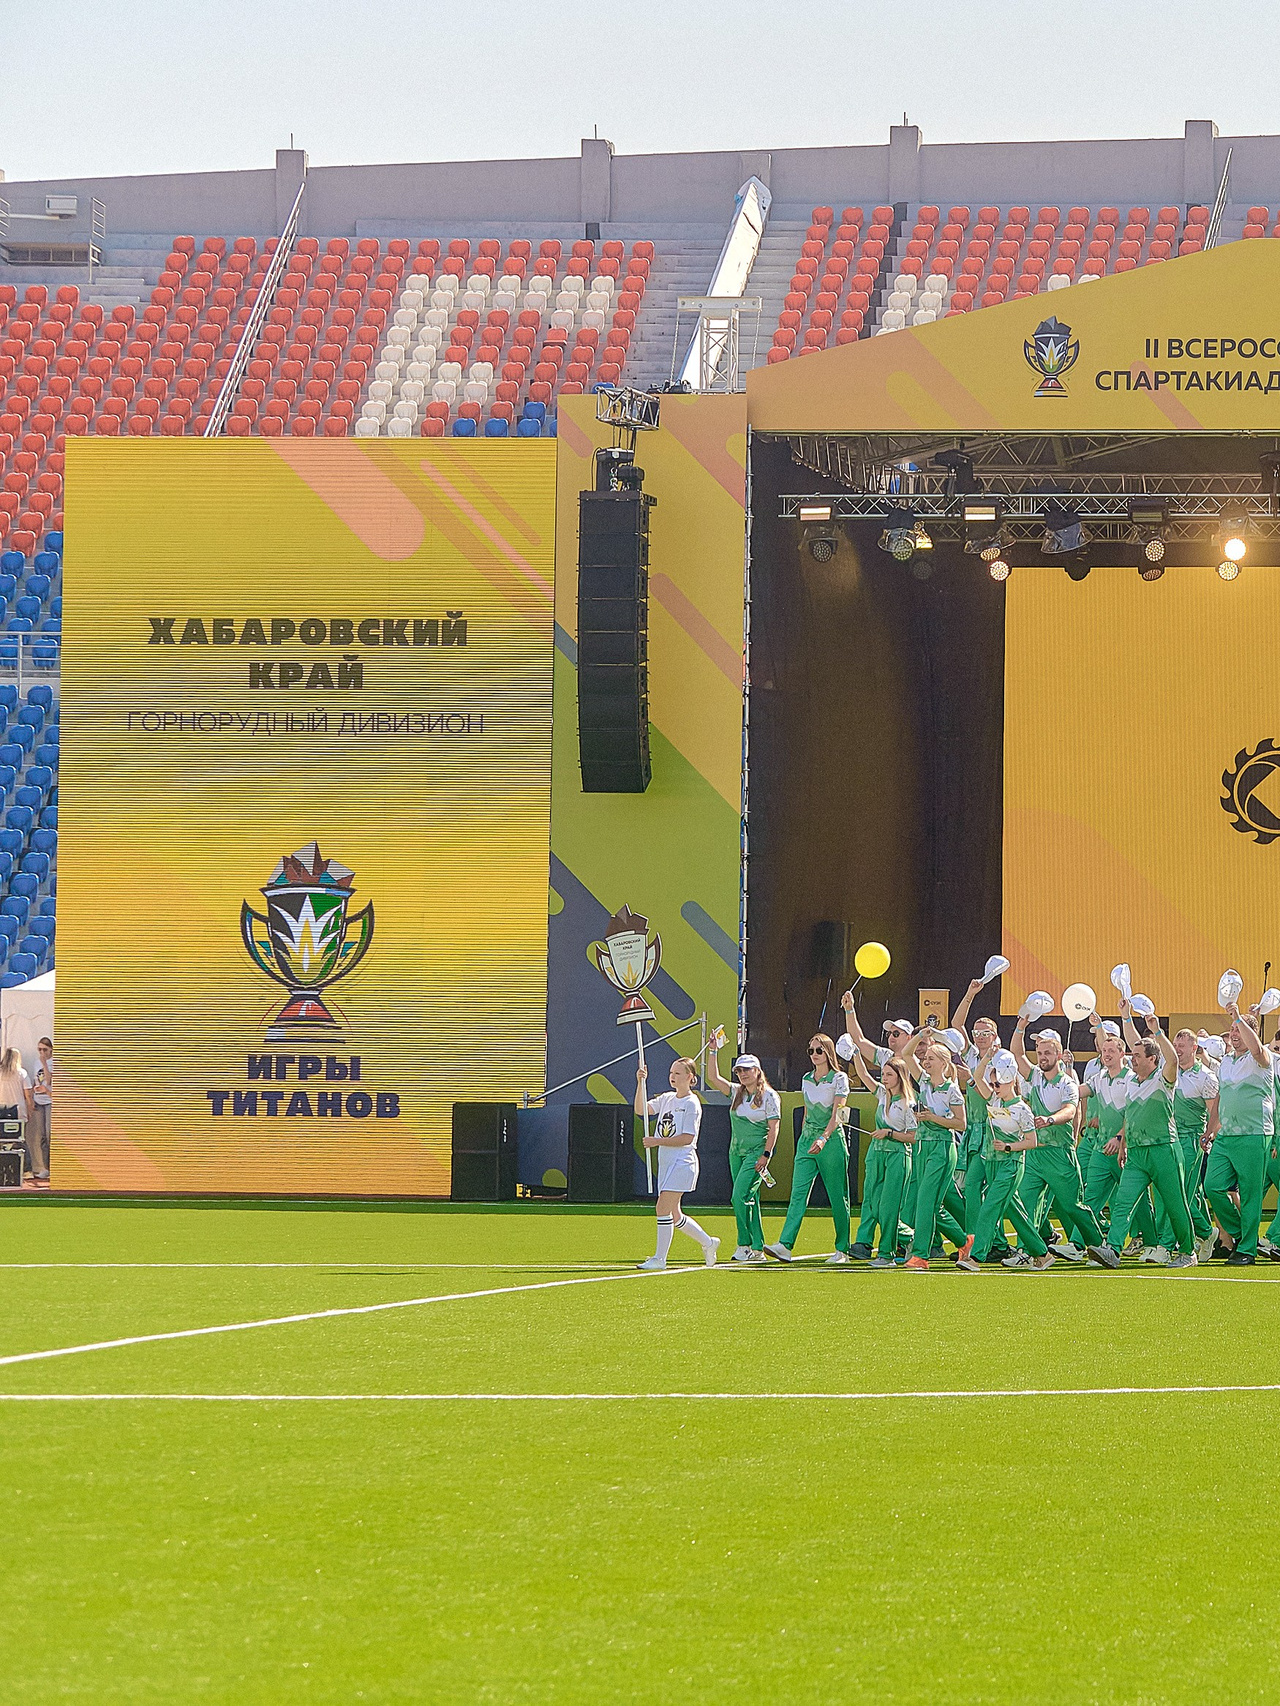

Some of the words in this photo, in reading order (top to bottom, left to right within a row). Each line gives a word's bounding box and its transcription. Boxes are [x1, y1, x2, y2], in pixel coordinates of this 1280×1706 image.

[148, 611, 468, 646] ХАБАРОВСКИЙ
[249, 654, 364, 689] КРАЙ
[127, 706, 328, 737] ГОРНОРУДНЫЙ
[337, 712, 485, 737] ДИВИЗИОН
[247, 1054, 361, 1081] ИГРЫ
[206, 1090, 401, 1119] ТИТАНОВ
